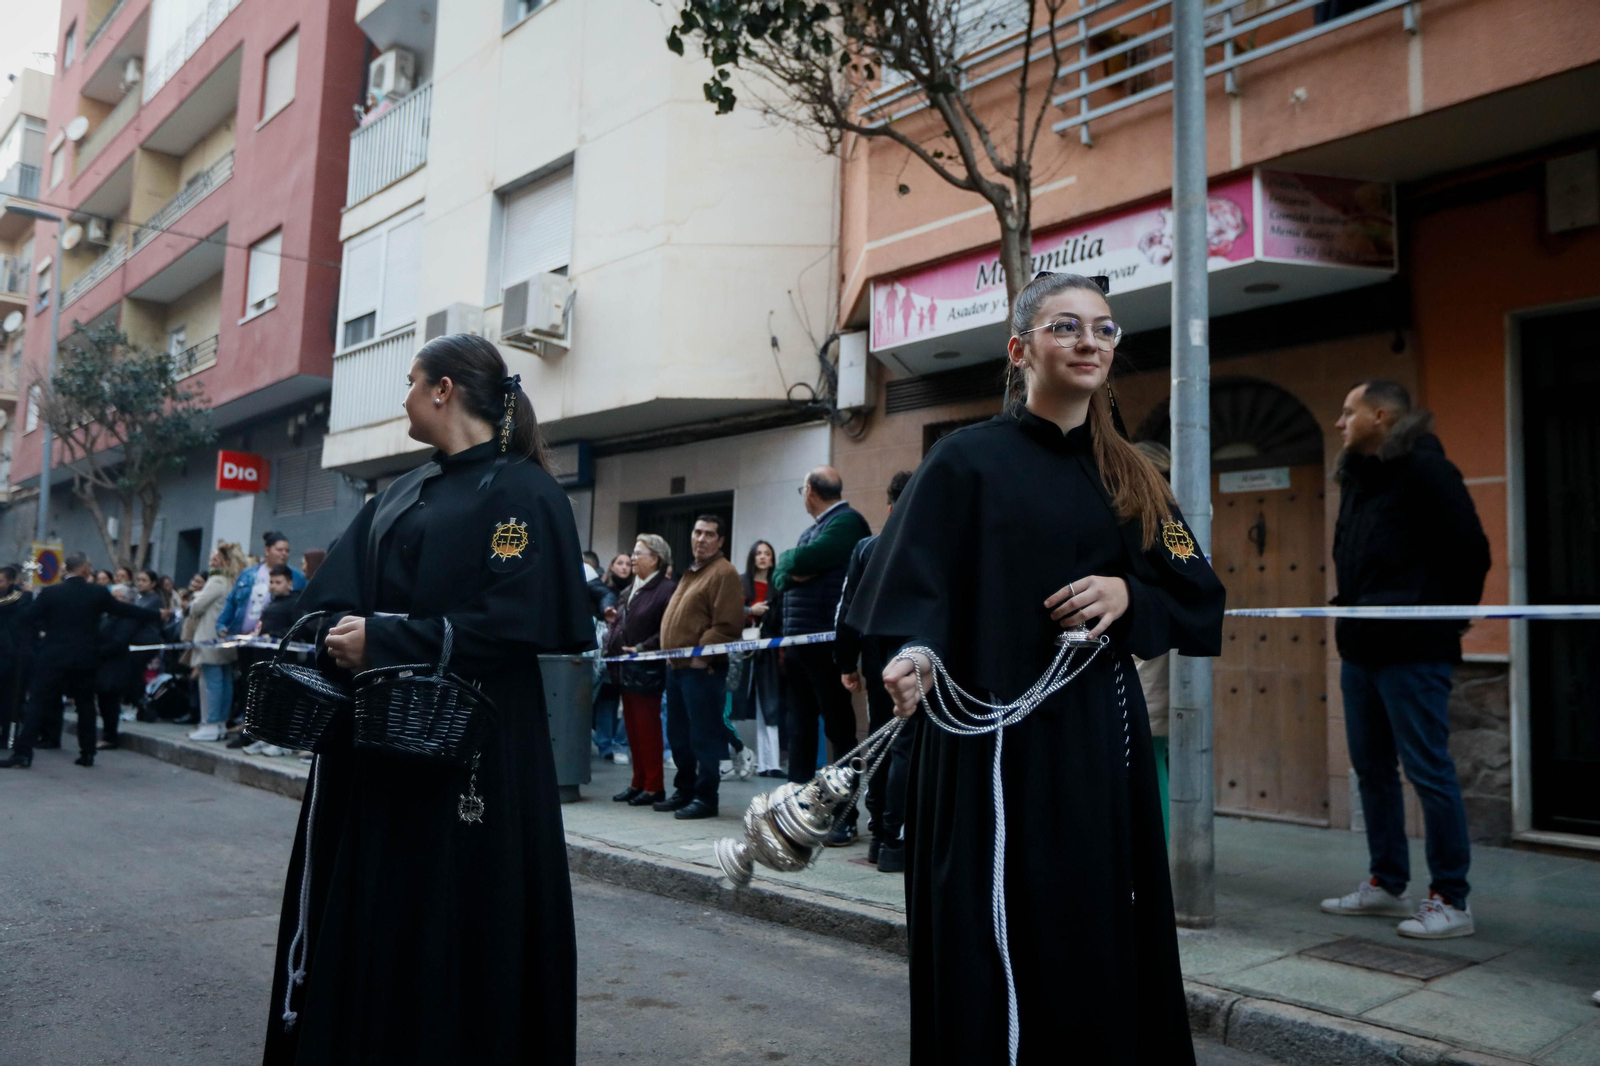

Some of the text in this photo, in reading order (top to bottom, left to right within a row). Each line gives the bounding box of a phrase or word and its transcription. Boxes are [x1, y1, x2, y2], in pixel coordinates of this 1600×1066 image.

[1030, 234, 1104, 273] milia
[947, 301, 987, 322] Asador
[989, 300, 1000, 314] y
[501, 392, 517, 453] LAGRIMAS
